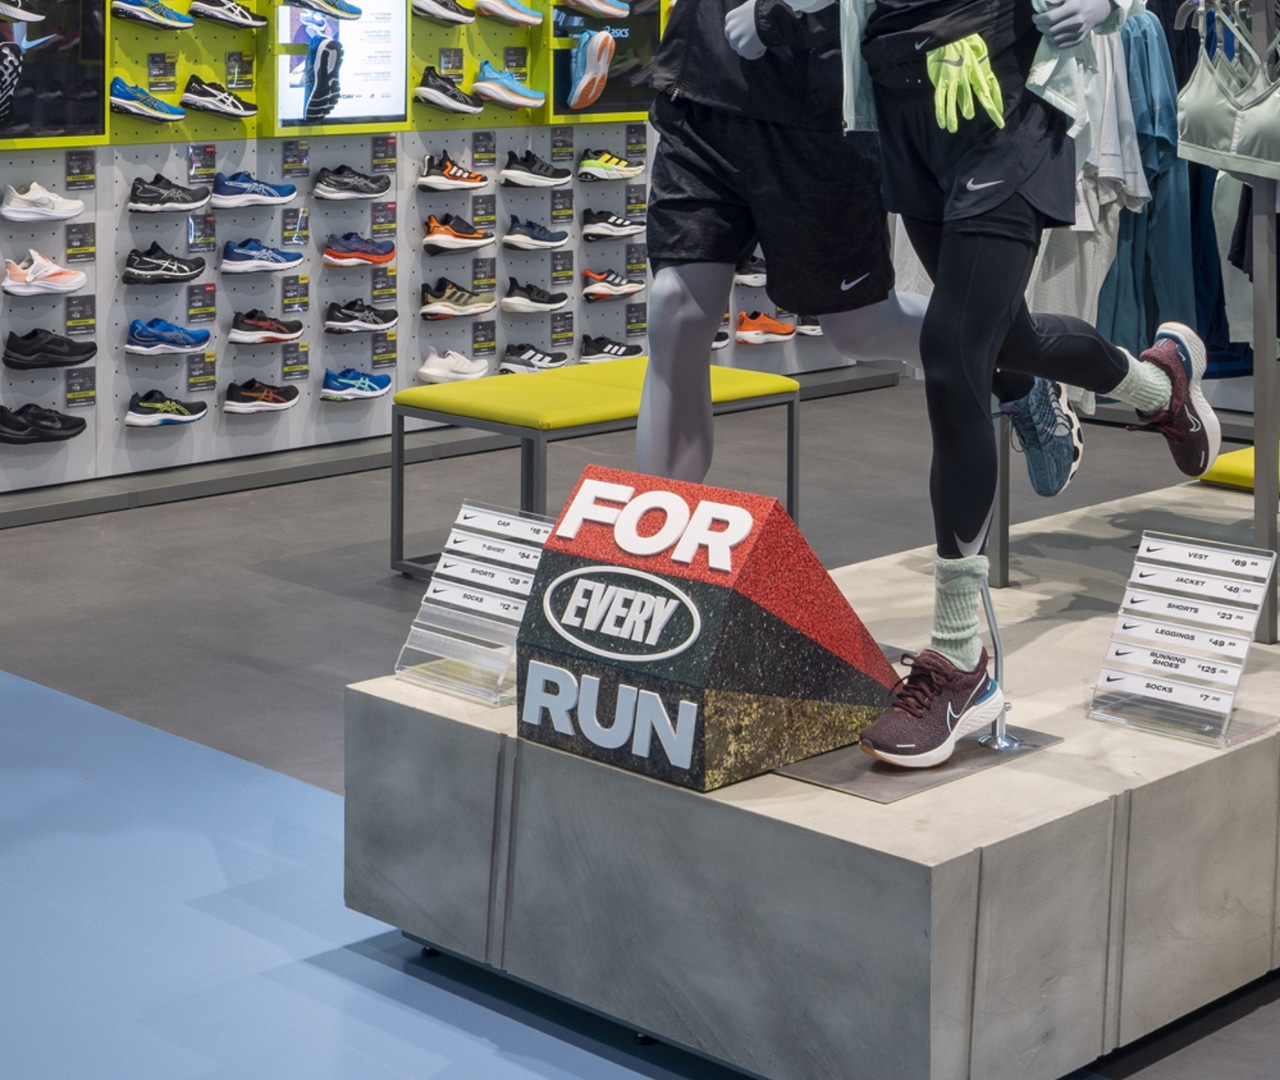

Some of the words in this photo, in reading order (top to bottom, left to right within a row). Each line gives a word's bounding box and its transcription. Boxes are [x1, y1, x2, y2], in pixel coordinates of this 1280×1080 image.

[555, 478, 754, 573] FOR
[482, 544, 506, 554] T-SHIRT
[1187, 551, 1210, 561] VEST
[470, 568, 495, 578] SHORTS
[1175, 576, 1206, 587] JACKET
[462, 593, 484, 603] SOCKS
[561, 577, 681, 646] EVERY
[1166, 602, 1199, 614] SHORTS
[1155, 627, 1195, 641] LEGGINGS
[1149, 651, 1186, 664] RUNNING
[1152, 659, 1180, 670] SHOES
[1145, 682, 1173, 693] SOCKS
[522, 659, 699, 770] RUN
